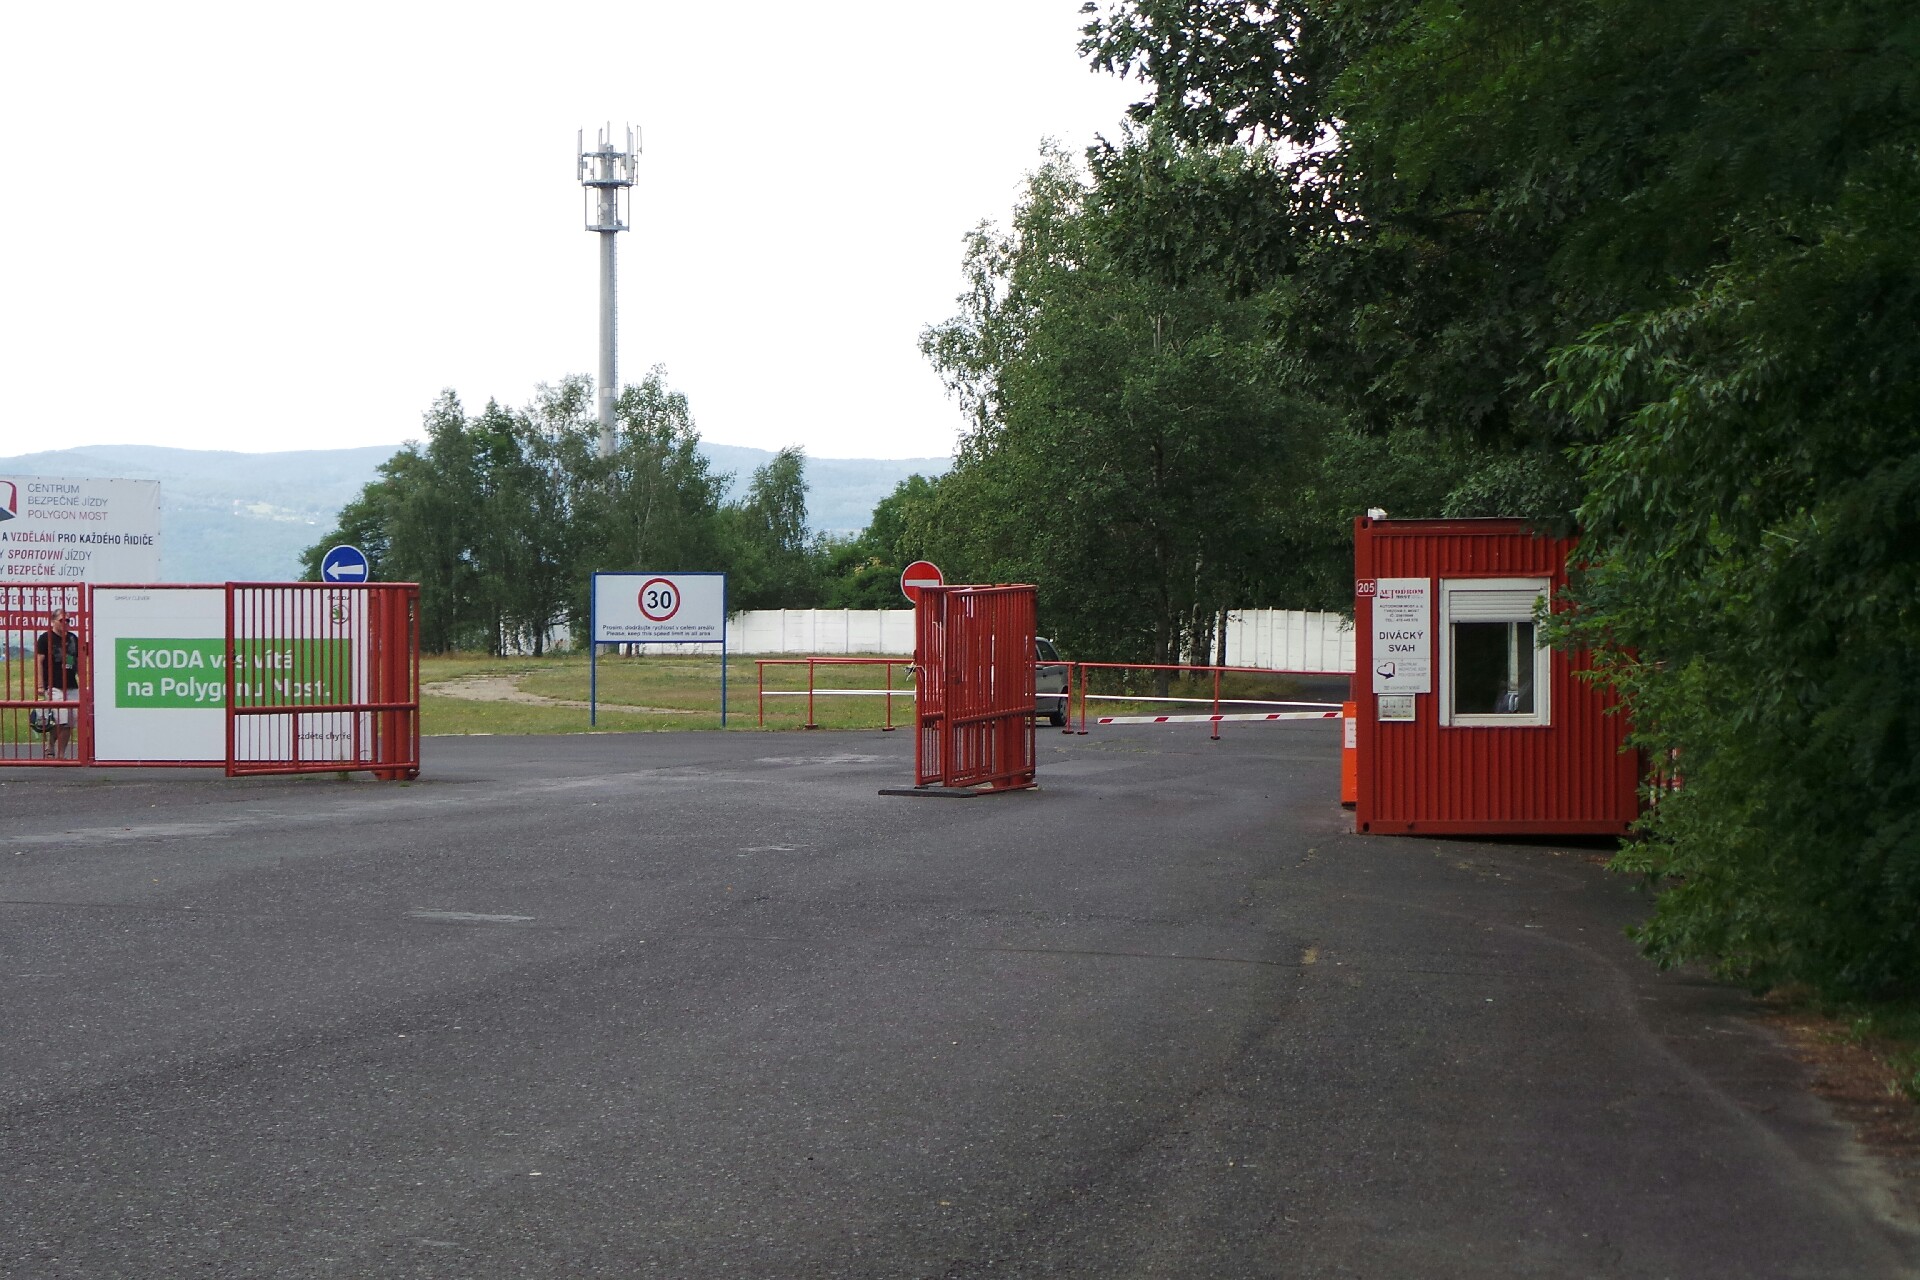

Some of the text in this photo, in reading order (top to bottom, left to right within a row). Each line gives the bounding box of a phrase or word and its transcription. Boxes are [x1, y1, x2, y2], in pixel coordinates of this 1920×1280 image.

[27, 483, 80, 493] CENTRUM
[27, 495, 108, 507] BEZPEČNÉ JÍZDY
[27, 510, 108, 521] POLYGON MOST
[1, 529, 154, 545] A VZDĚLÁNÍ PRO KAŽDÉHO ŘIDIČE
[8, 547, 65, 560] SPORTOVNÍ
[64, 549, 92, 561] JÍZDY
[7, 563, 55, 576] BEZPEČNÉ
[58, 563, 85, 576] JÍZDY
[1358, 583, 1375, 593] 205
[647, 590, 672, 609] 30
[1379, 629, 1424, 640] DIVÁCKÝ
[1388, 644, 1416, 653] SVAH
[126, 645, 204, 670] ŠKODA
[127, 681, 154, 697] na
